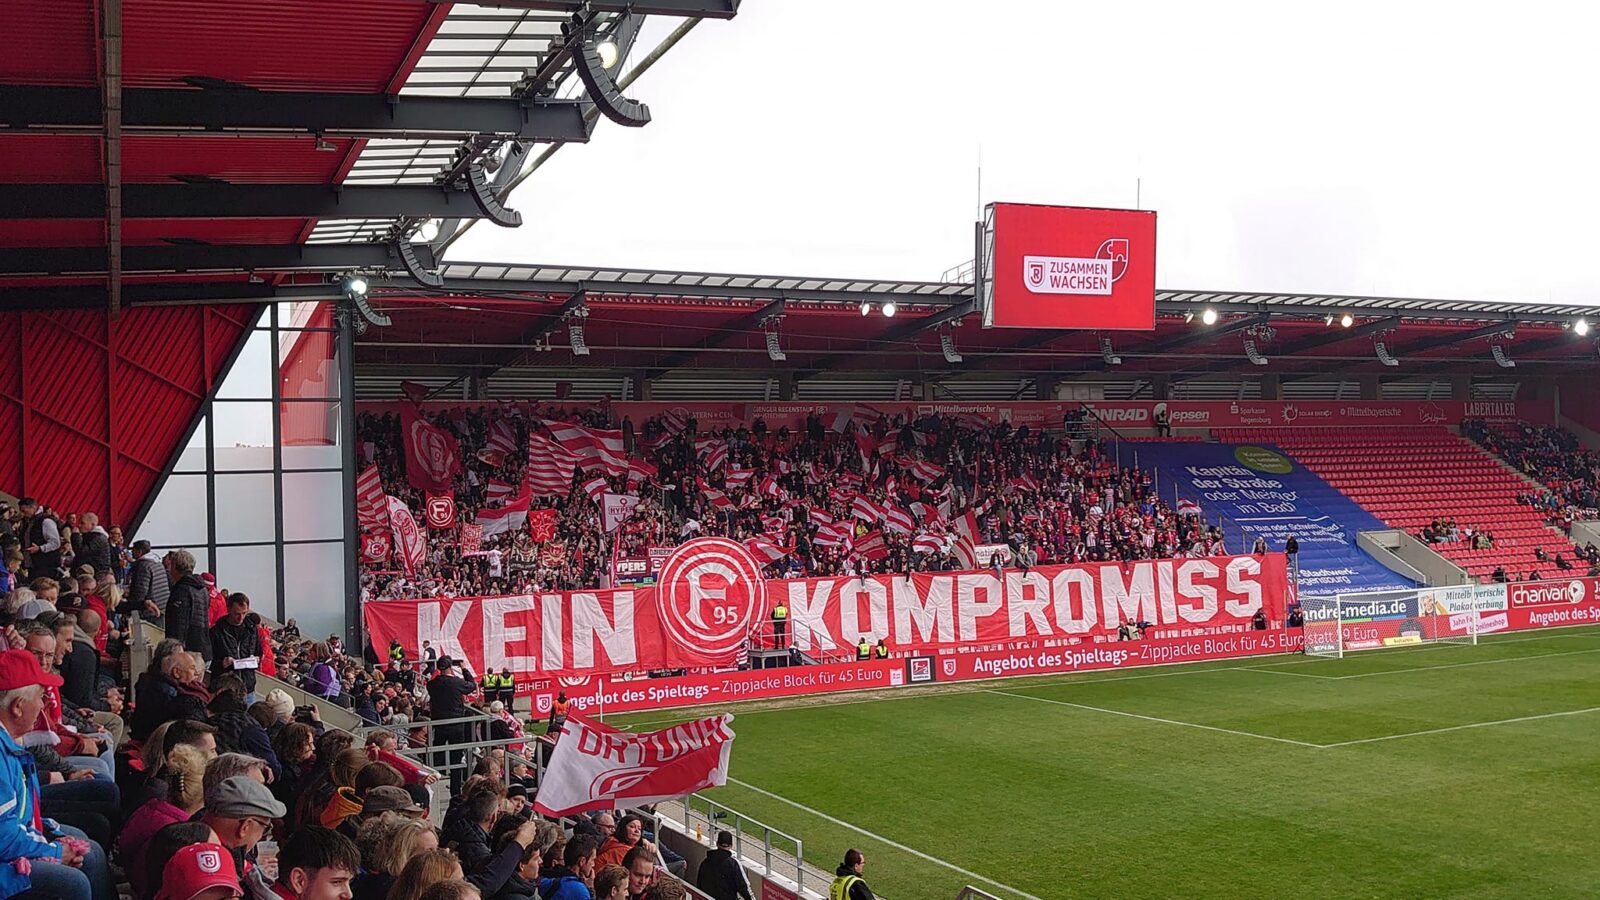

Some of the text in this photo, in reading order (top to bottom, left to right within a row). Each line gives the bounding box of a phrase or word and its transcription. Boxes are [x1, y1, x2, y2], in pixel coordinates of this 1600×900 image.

[1050, 261, 1108, 275] ZUSAMMEN
[1050, 275, 1108, 290] WACHSEN
[1347, 407, 1402, 417] Mittelbayerische
[1464, 402, 1516, 417] LABERTALER
[1240, 416, 1272, 425] Regensburg
[1184, 465, 1256, 478] Kapitän
[1191, 478, 1283, 489] der Straße
[1204, 490, 1240, 501] oder
[1233, 502, 1260, 514] im
[1298, 576, 1352, 586] egensburg
[1446, 588, 1505, 601] Mittelbyerische
[1513, 584, 1568, 604] charivari
[786, 555, 1264, 651] KOMPROMISS
[713, 606, 738, 625] 95
[1302, 601, 1407, 621] andre-media.de
[1529, 611, 1570, 627] Angebot
[1571, 609, 1588, 620] des
[416, 590, 638, 679] KEIN
[1308, 632, 1332, 644] statt
[1353, 627, 1378, 640] Euro
[974, 655, 1034, 675] Angebot
[1038, 652, 1062, 667] des
[1065, 646, 1128, 669] Spieltags
[1140, 640, 1201, 663] Zippjacke
[1204, 638, 1236, 654] Block
[1239, 636, 1257, 650] für
[1260, 635, 1275, 648] 45
[1279, 633, 1304, 646] Euro
[514, 680, 551, 694] REIHEIT
[570, 689, 619, 710] ngebot
[621, 687, 646, 702] des
[648, 681, 710, 701] Spieltags
[722, 676, 780, 695] Zippjacke
[784, 669, 816, 686] Block
[819, 668, 836, 684] für
[838, 670, 854, 682] 45
[857, 667, 883, 681] Euro
[573, 715, 729, 766] ORTUNA
